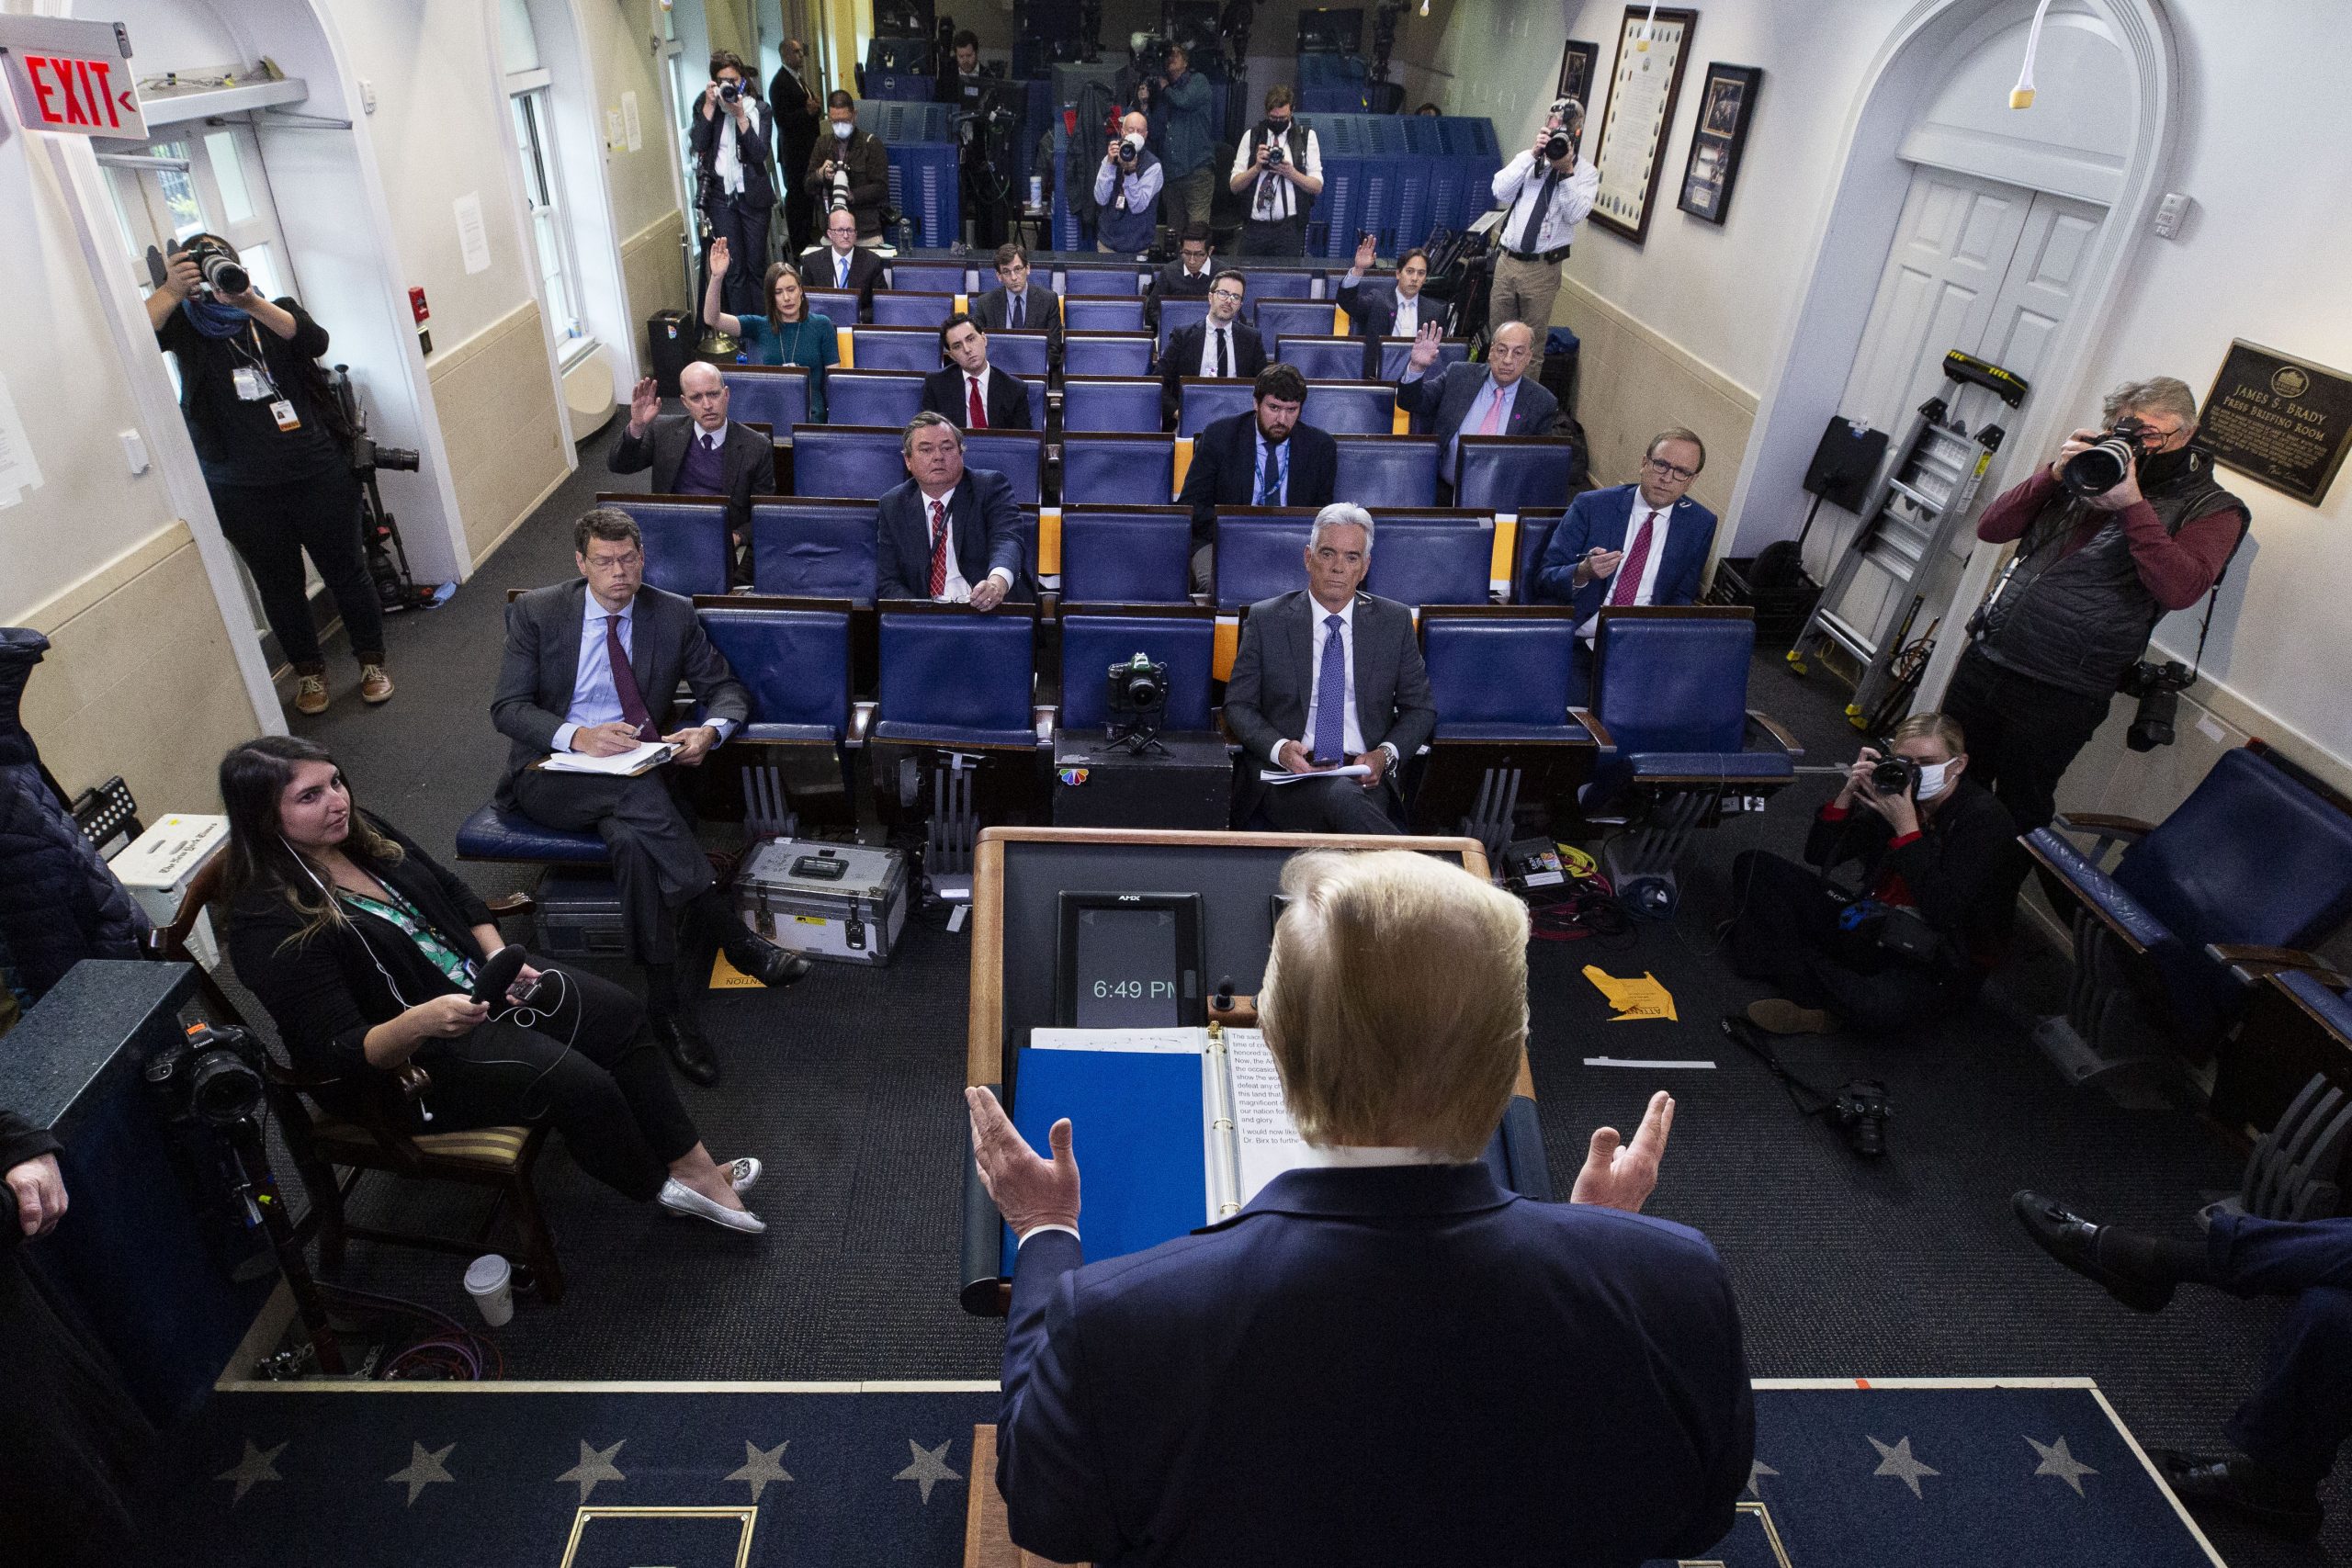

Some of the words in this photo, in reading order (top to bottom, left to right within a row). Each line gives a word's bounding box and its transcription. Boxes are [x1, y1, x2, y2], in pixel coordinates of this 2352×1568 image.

[24, 55, 119, 129] EXIT
[2223, 396, 2249, 412] PRESS
[2251, 406, 2292, 429] BRIEFING
[2295, 423, 2325, 441] ROOM
[2233, 384, 2268, 404] JAMES
[2271, 397, 2280, 410] S.
[2287, 402, 2326, 425] BRADY
[726, 977, 762, 986] NTION
[1093, 980, 1142, 998] 6:49
[193, 1037, 214, 1049] Canon
